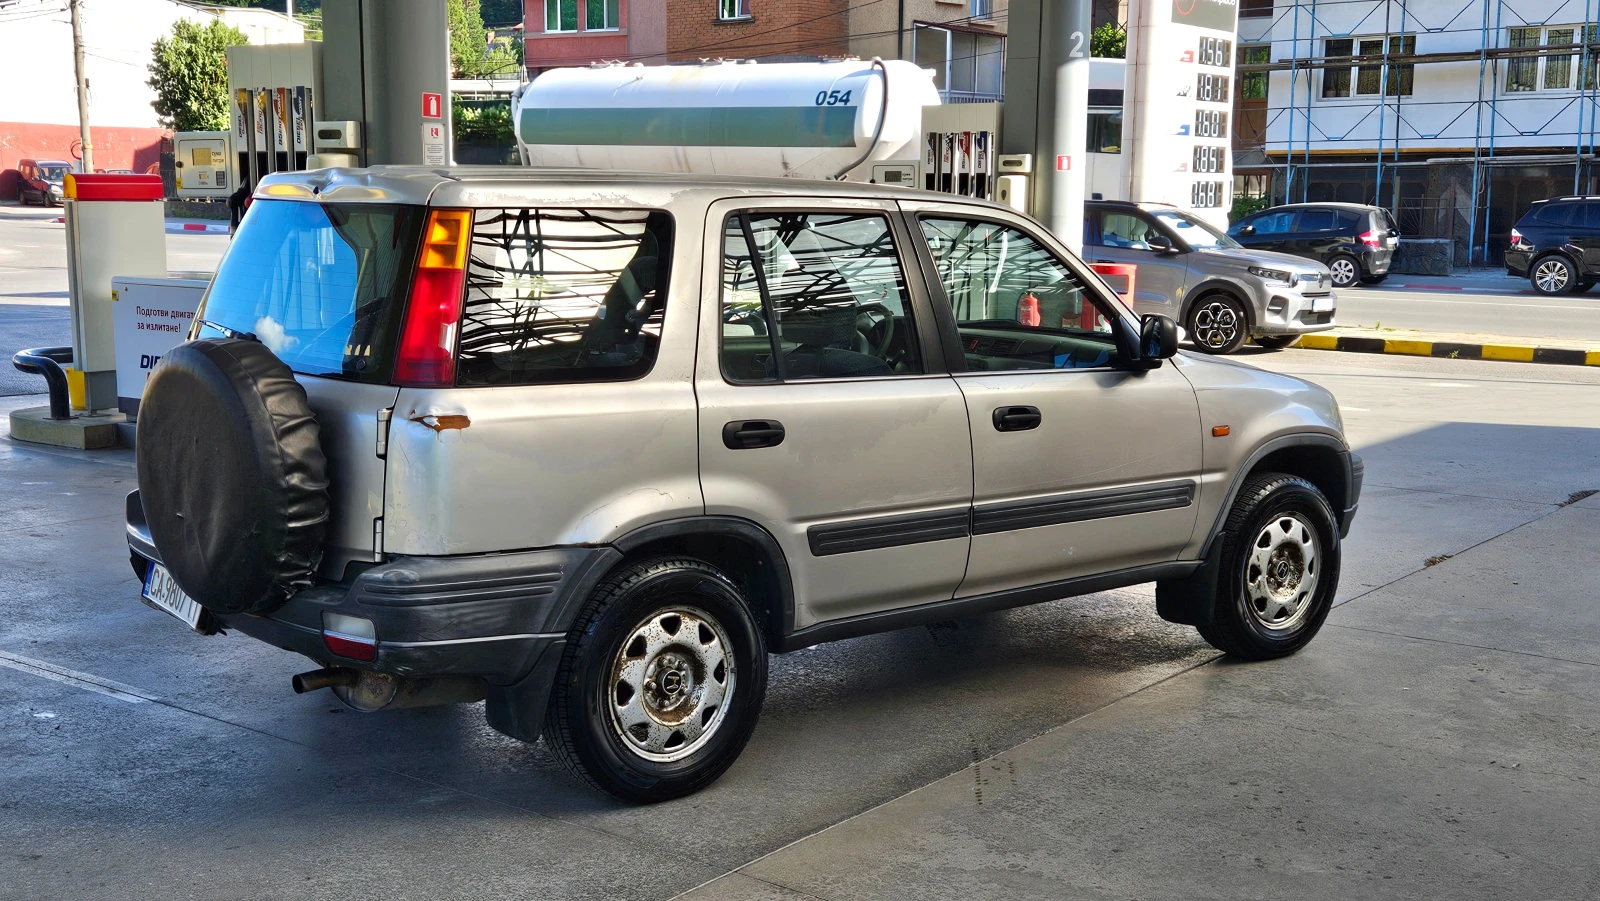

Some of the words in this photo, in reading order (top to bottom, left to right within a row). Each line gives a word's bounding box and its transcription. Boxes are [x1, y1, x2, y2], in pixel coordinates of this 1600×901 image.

[1069, 31, 1084, 57] 2
[815, 90, 852, 106] 054
[136, 306, 169, 318] Подготви
[137, 322, 145, 330] за
[146, 322, 181, 333] излитане!
